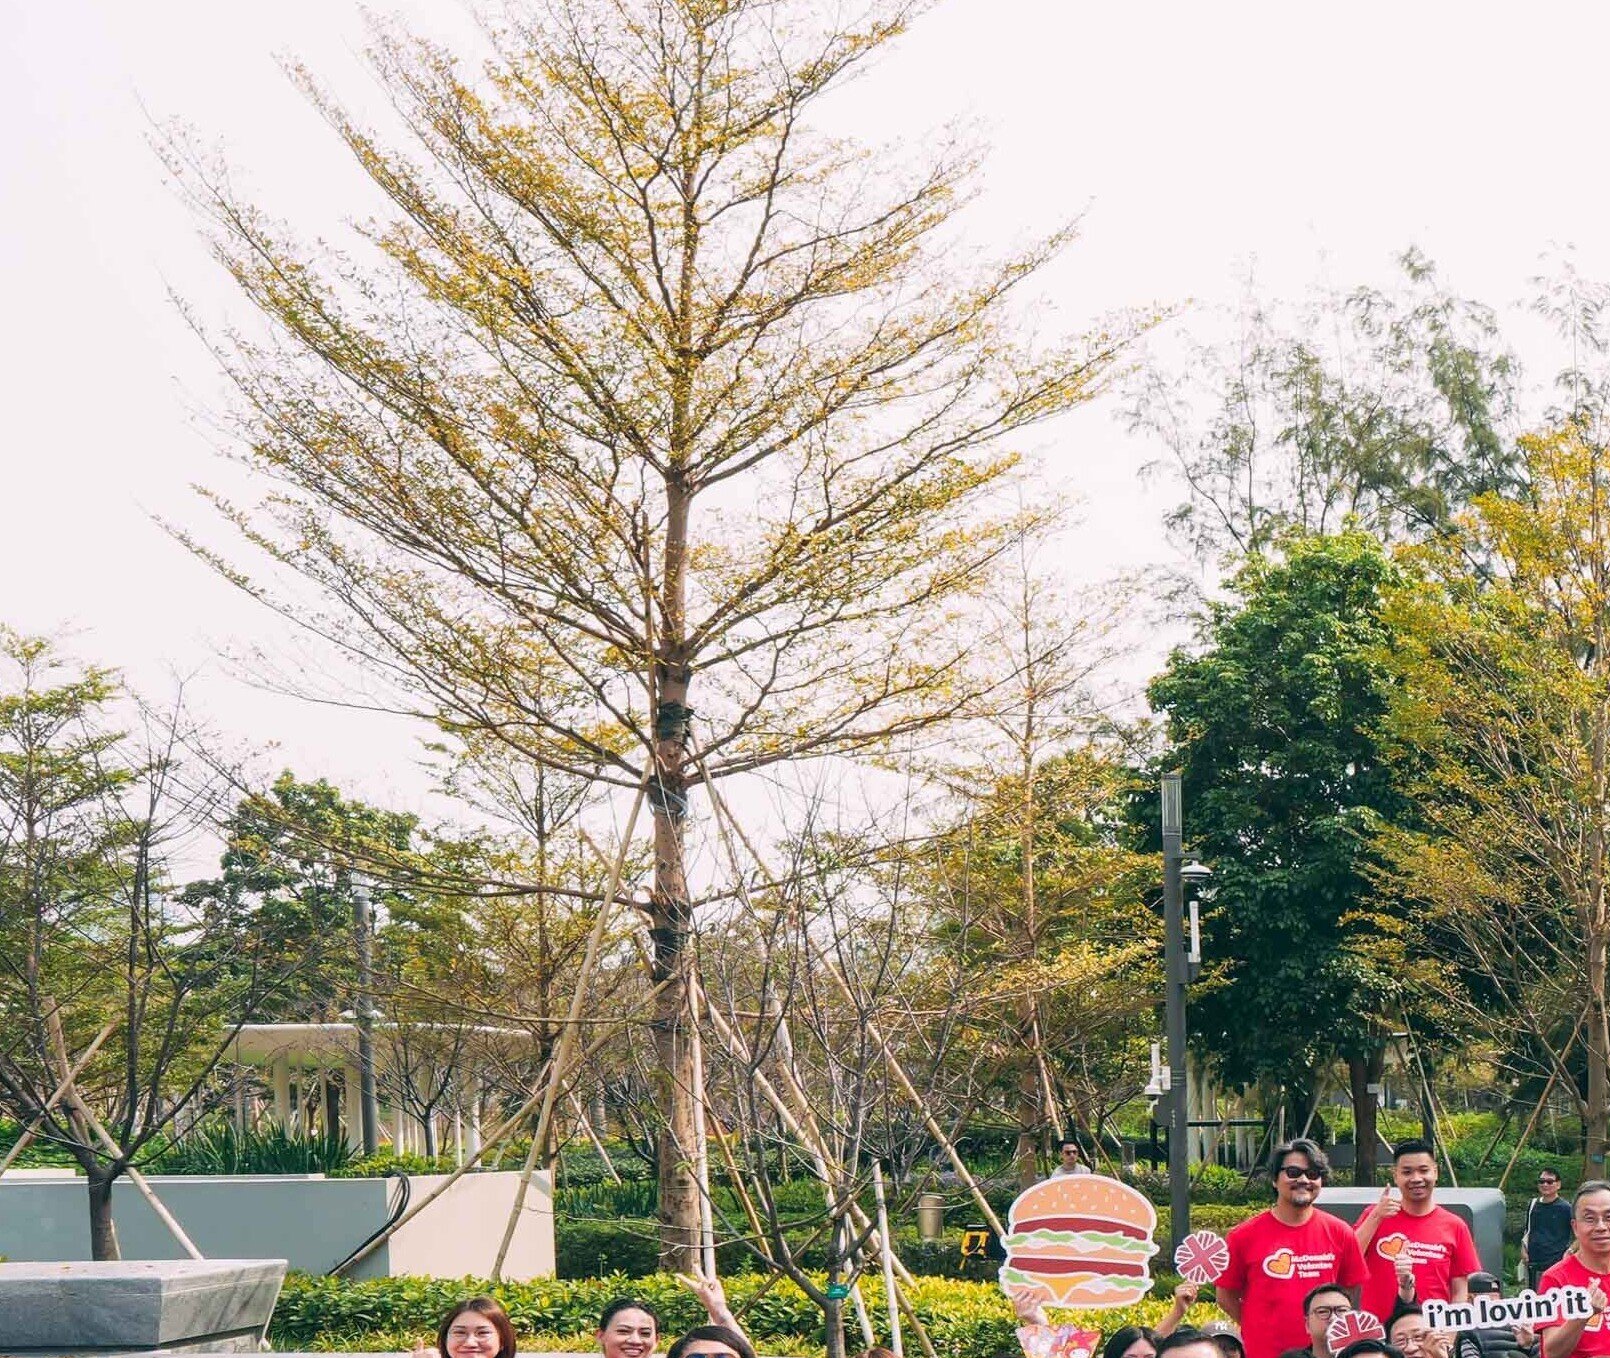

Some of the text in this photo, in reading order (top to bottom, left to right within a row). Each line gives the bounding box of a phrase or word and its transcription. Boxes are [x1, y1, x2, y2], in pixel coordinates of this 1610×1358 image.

[1427, 1289, 1589, 1328] i'm lovin' it
